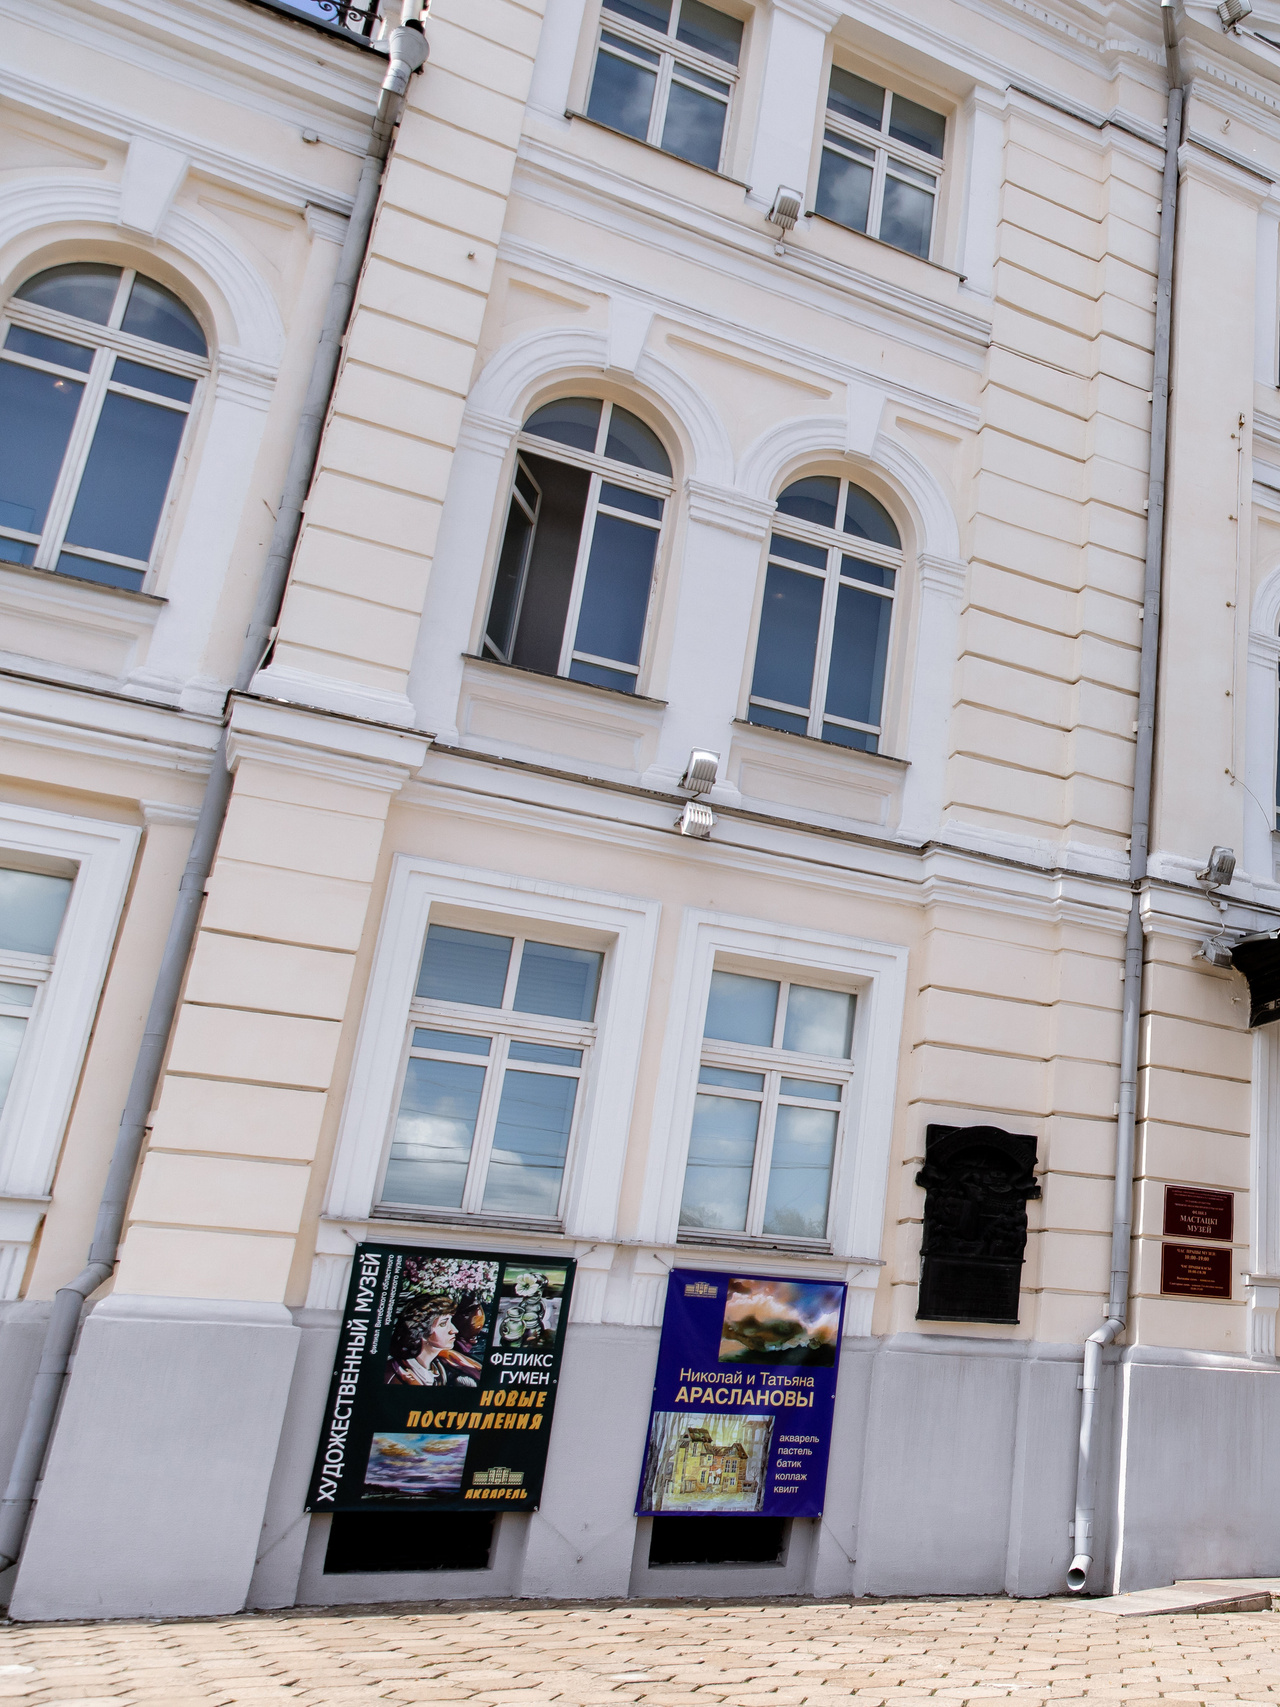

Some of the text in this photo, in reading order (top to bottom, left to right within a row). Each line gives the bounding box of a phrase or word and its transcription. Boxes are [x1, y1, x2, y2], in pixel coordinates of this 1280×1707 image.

[1180, 1215, 1218, 1225] МАСТАЦКІ
[1187, 1224, 1212, 1233] МУЗЕЙ
[385, 1255, 403, 1325] краеведческого музея
[370, 1254, 394, 1354] филиал Витебского областного
[490, 1352, 553, 1367] ФЕЛИКС
[317, 1253, 382, 1501] ХУДОЖЕСТВЕННЫЙ МУЗЕЙ
[500, 1371, 550, 1385] ГУМЕН
[679, 1367, 815, 1387] Николай и Татьяна
[479, 1389, 547, 1408] НОВЫЕ
[675, 1386, 815, 1407] АРАСЛАНОВЫ
[406, 1410, 543, 1430] ПОСТУПЛЕНИЯ
[779, 1434, 820, 1444] акварель
[777, 1447, 813, 1456] пастель
[776, 1458, 802, 1468] батик
[775, 1473, 808, 1481] коллаж
[464, 1488, 528, 1500] АКВАРЕЛЬ
